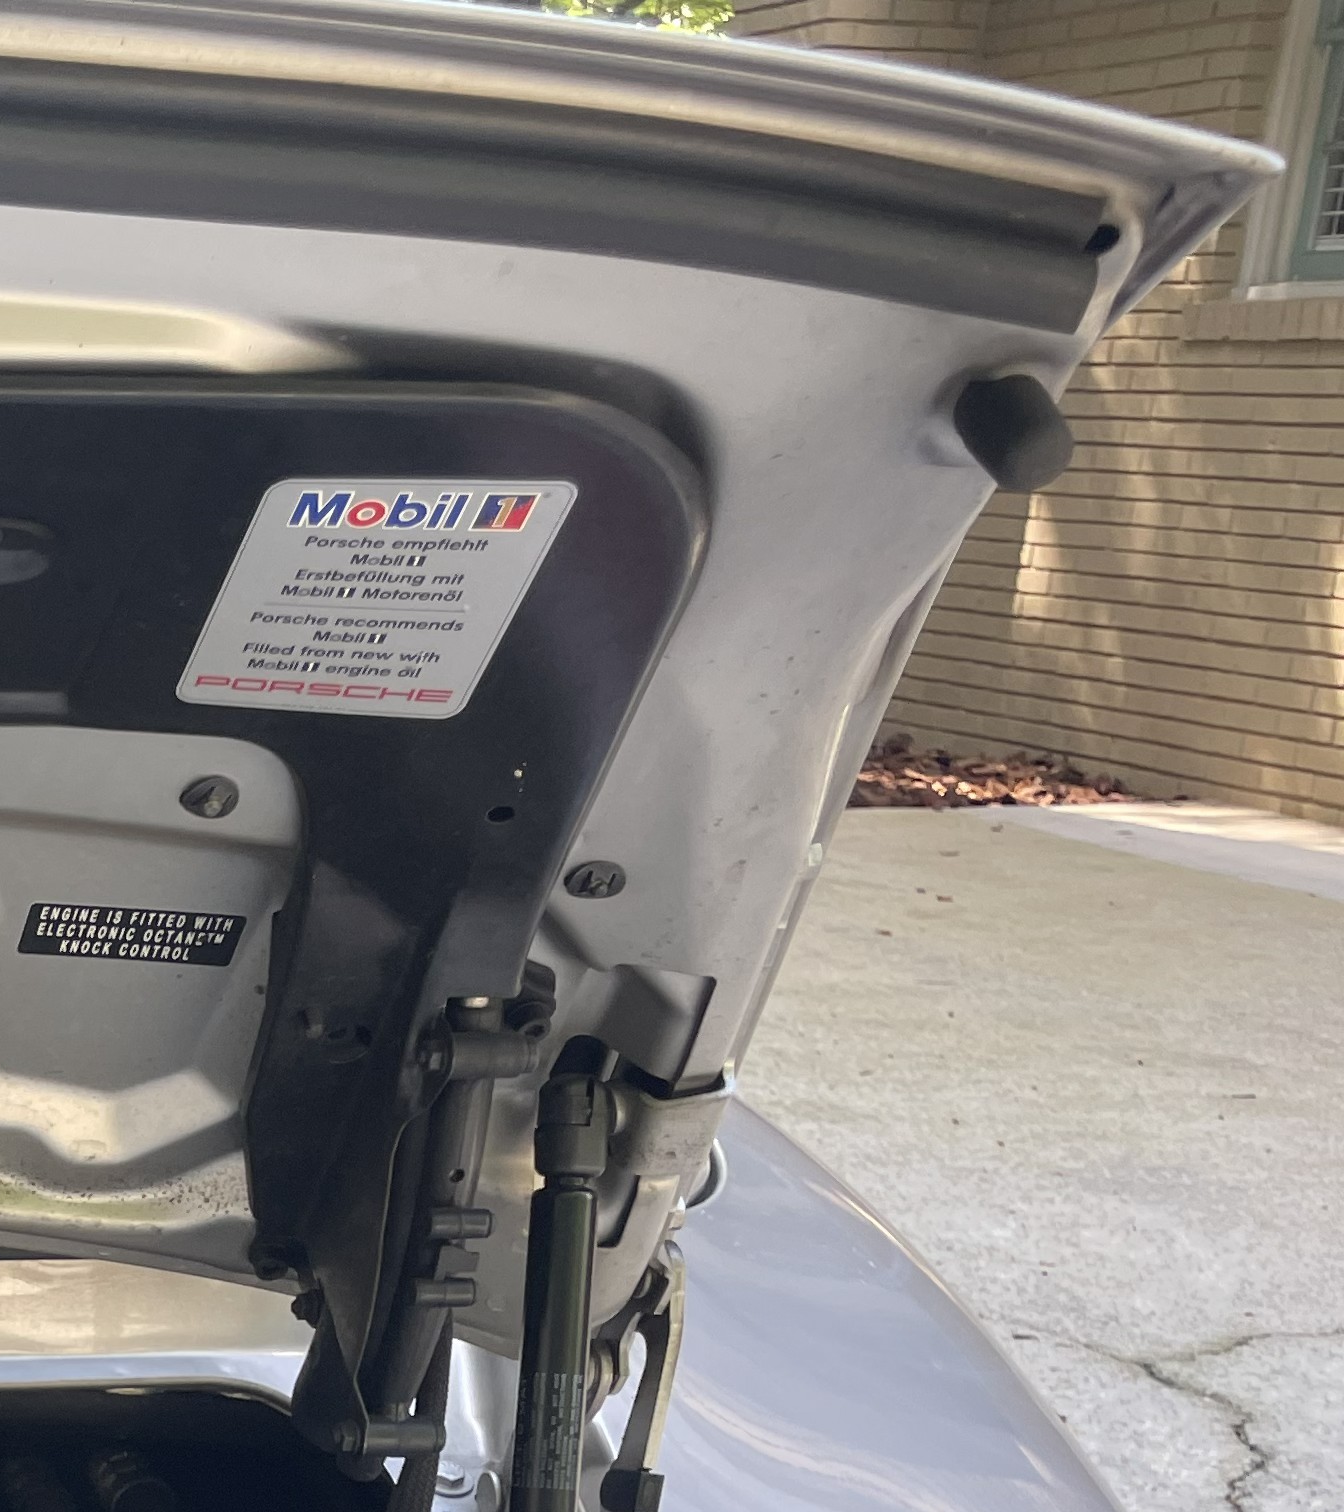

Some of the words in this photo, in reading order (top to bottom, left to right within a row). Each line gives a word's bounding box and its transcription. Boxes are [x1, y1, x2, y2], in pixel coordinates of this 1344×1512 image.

[286, 490, 473, 530] Mobil
[304, 535, 387, 551] Porsche
[391, 537, 490, 554] empfiehlt
[350, 552, 405, 568] Mobil
[294, 568, 426, 587] Erstbefüllung
[431, 572, 465, 586] mit
[280, 583, 336, 599] Mobil
[361, 586, 464, 604] Motorenöl
[250, 611, 329, 628] Porsche
[334, 617, 465, 633] recommends
[312, 629, 367, 645] Mobil
[242, 641, 296, 658] Filled
[299, 646, 346, 661] from
[350, 649, 395, 662] new
[399, 651, 442, 666] with
[246, 657, 301, 673] Mobil
[324, 664, 393, 679] engine
[194, 673, 454, 705] PORSCHE
[39, 905, 101, 924] ENGINE
[106, 909, 123, 925] IS
[130, 911, 187, 929] FITTED
[193, 915, 235, 932] WITH
[36, 921, 138, 941] ELECTRONIC
[59, 940, 113, 956] KNOCK
[118, 942, 191, 962] CONTROL
